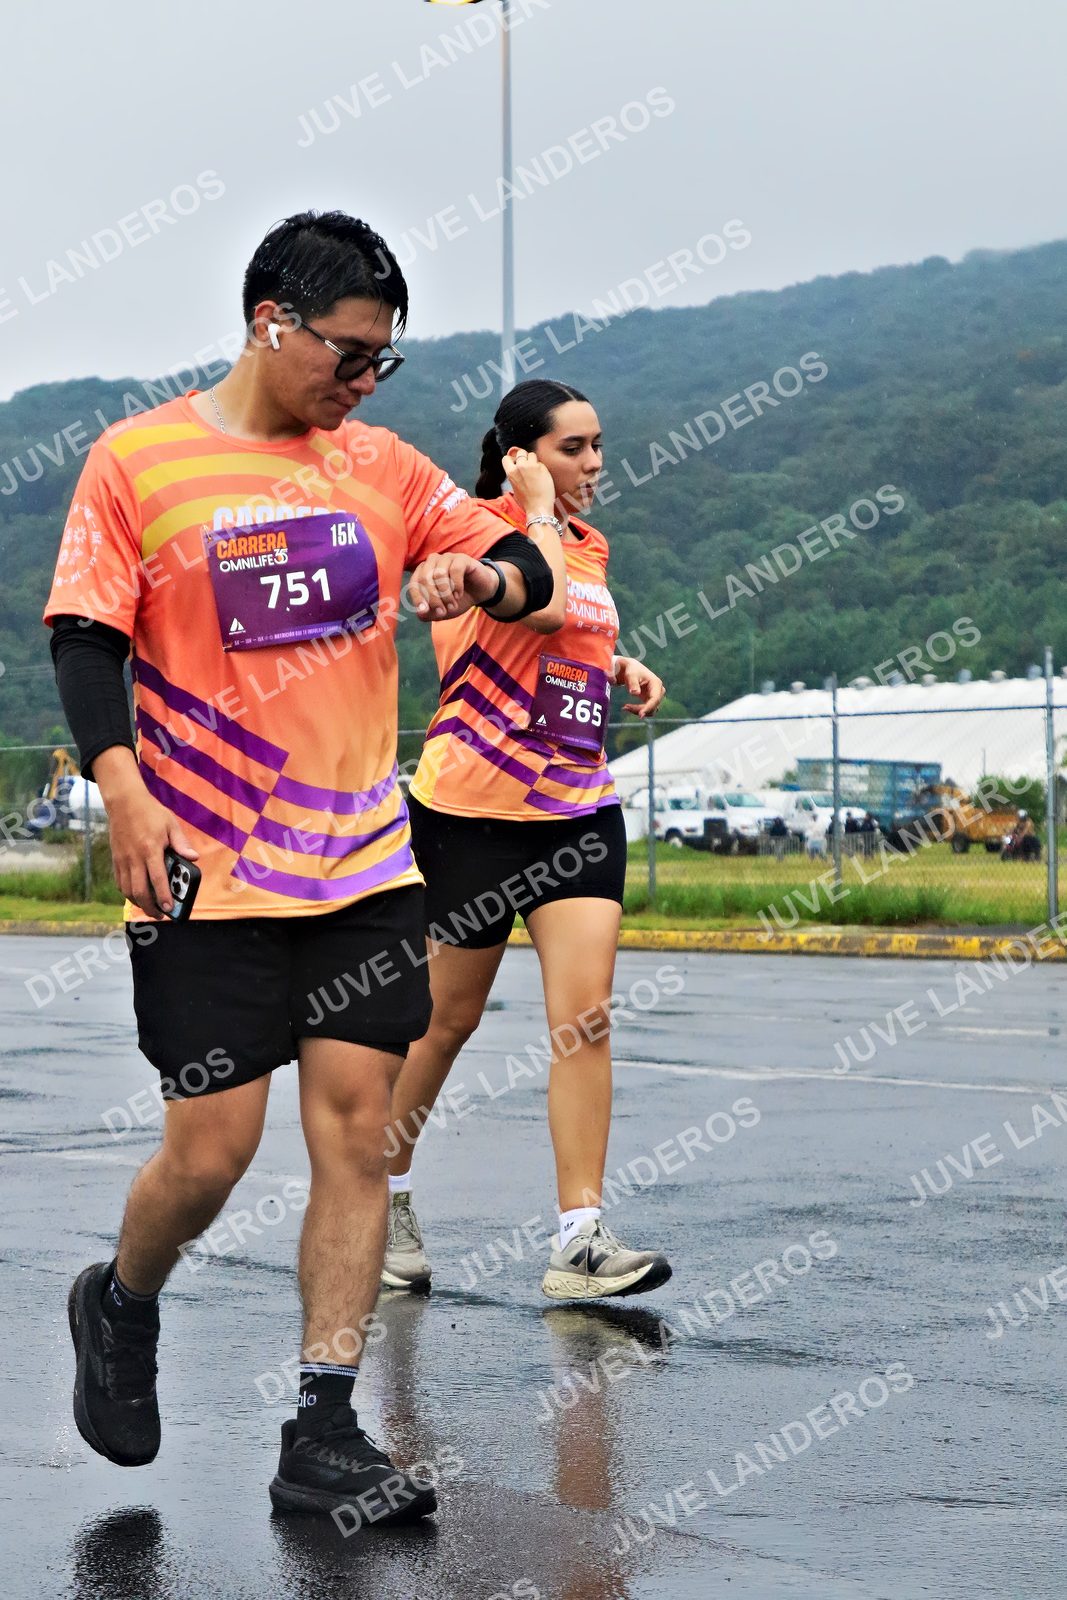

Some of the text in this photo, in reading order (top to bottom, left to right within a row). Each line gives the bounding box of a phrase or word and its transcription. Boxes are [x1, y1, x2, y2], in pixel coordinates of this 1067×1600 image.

[216, 531, 288, 559] CARRERA
[330, 522, 358, 547] 15K
[259, 568, 331, 609] 751
[547, 661, 588, 682] CARRERA
[560, 694, 603, 727] 265
